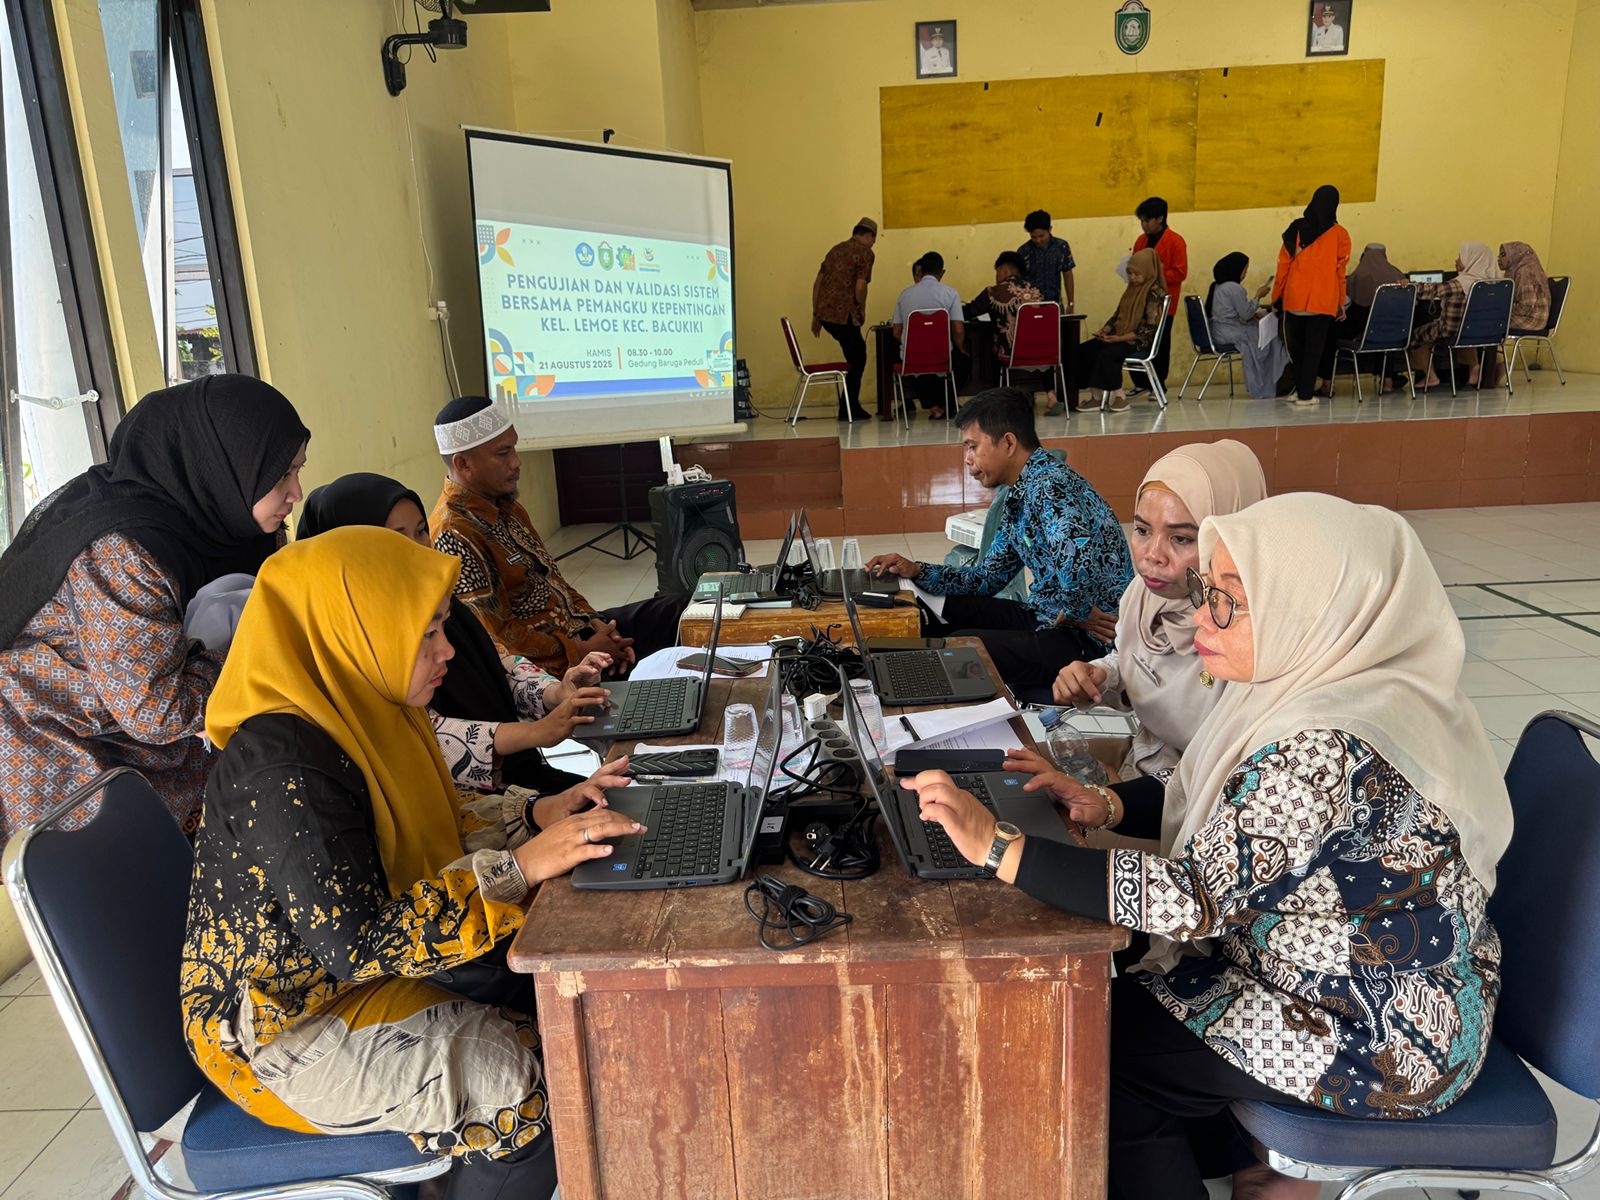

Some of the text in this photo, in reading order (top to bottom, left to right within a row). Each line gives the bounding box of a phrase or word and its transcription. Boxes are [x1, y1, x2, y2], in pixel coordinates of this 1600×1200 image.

[507, 274, 719, 299] PENGUJIAN DAN VALIDASI SISTEM
[502, 295, 726, 316] BERSAMA PEMANGKU KEPENTINGAN
[541, 317, 703, 333] KEL. LEMOE KEC. BACUKIKI
[586, 349, 612, 358] KAMIS
[627, 348, 649, 357] 08.30
[653, 348, 673, 357] 10.00
[539, 360, 613, 370] 21 AGUSTUS 2025
[628, 359, 657, 370] Gedung
[658, 359, 683, 368] Baruga
[684, 358, 704, 366] Peduli
